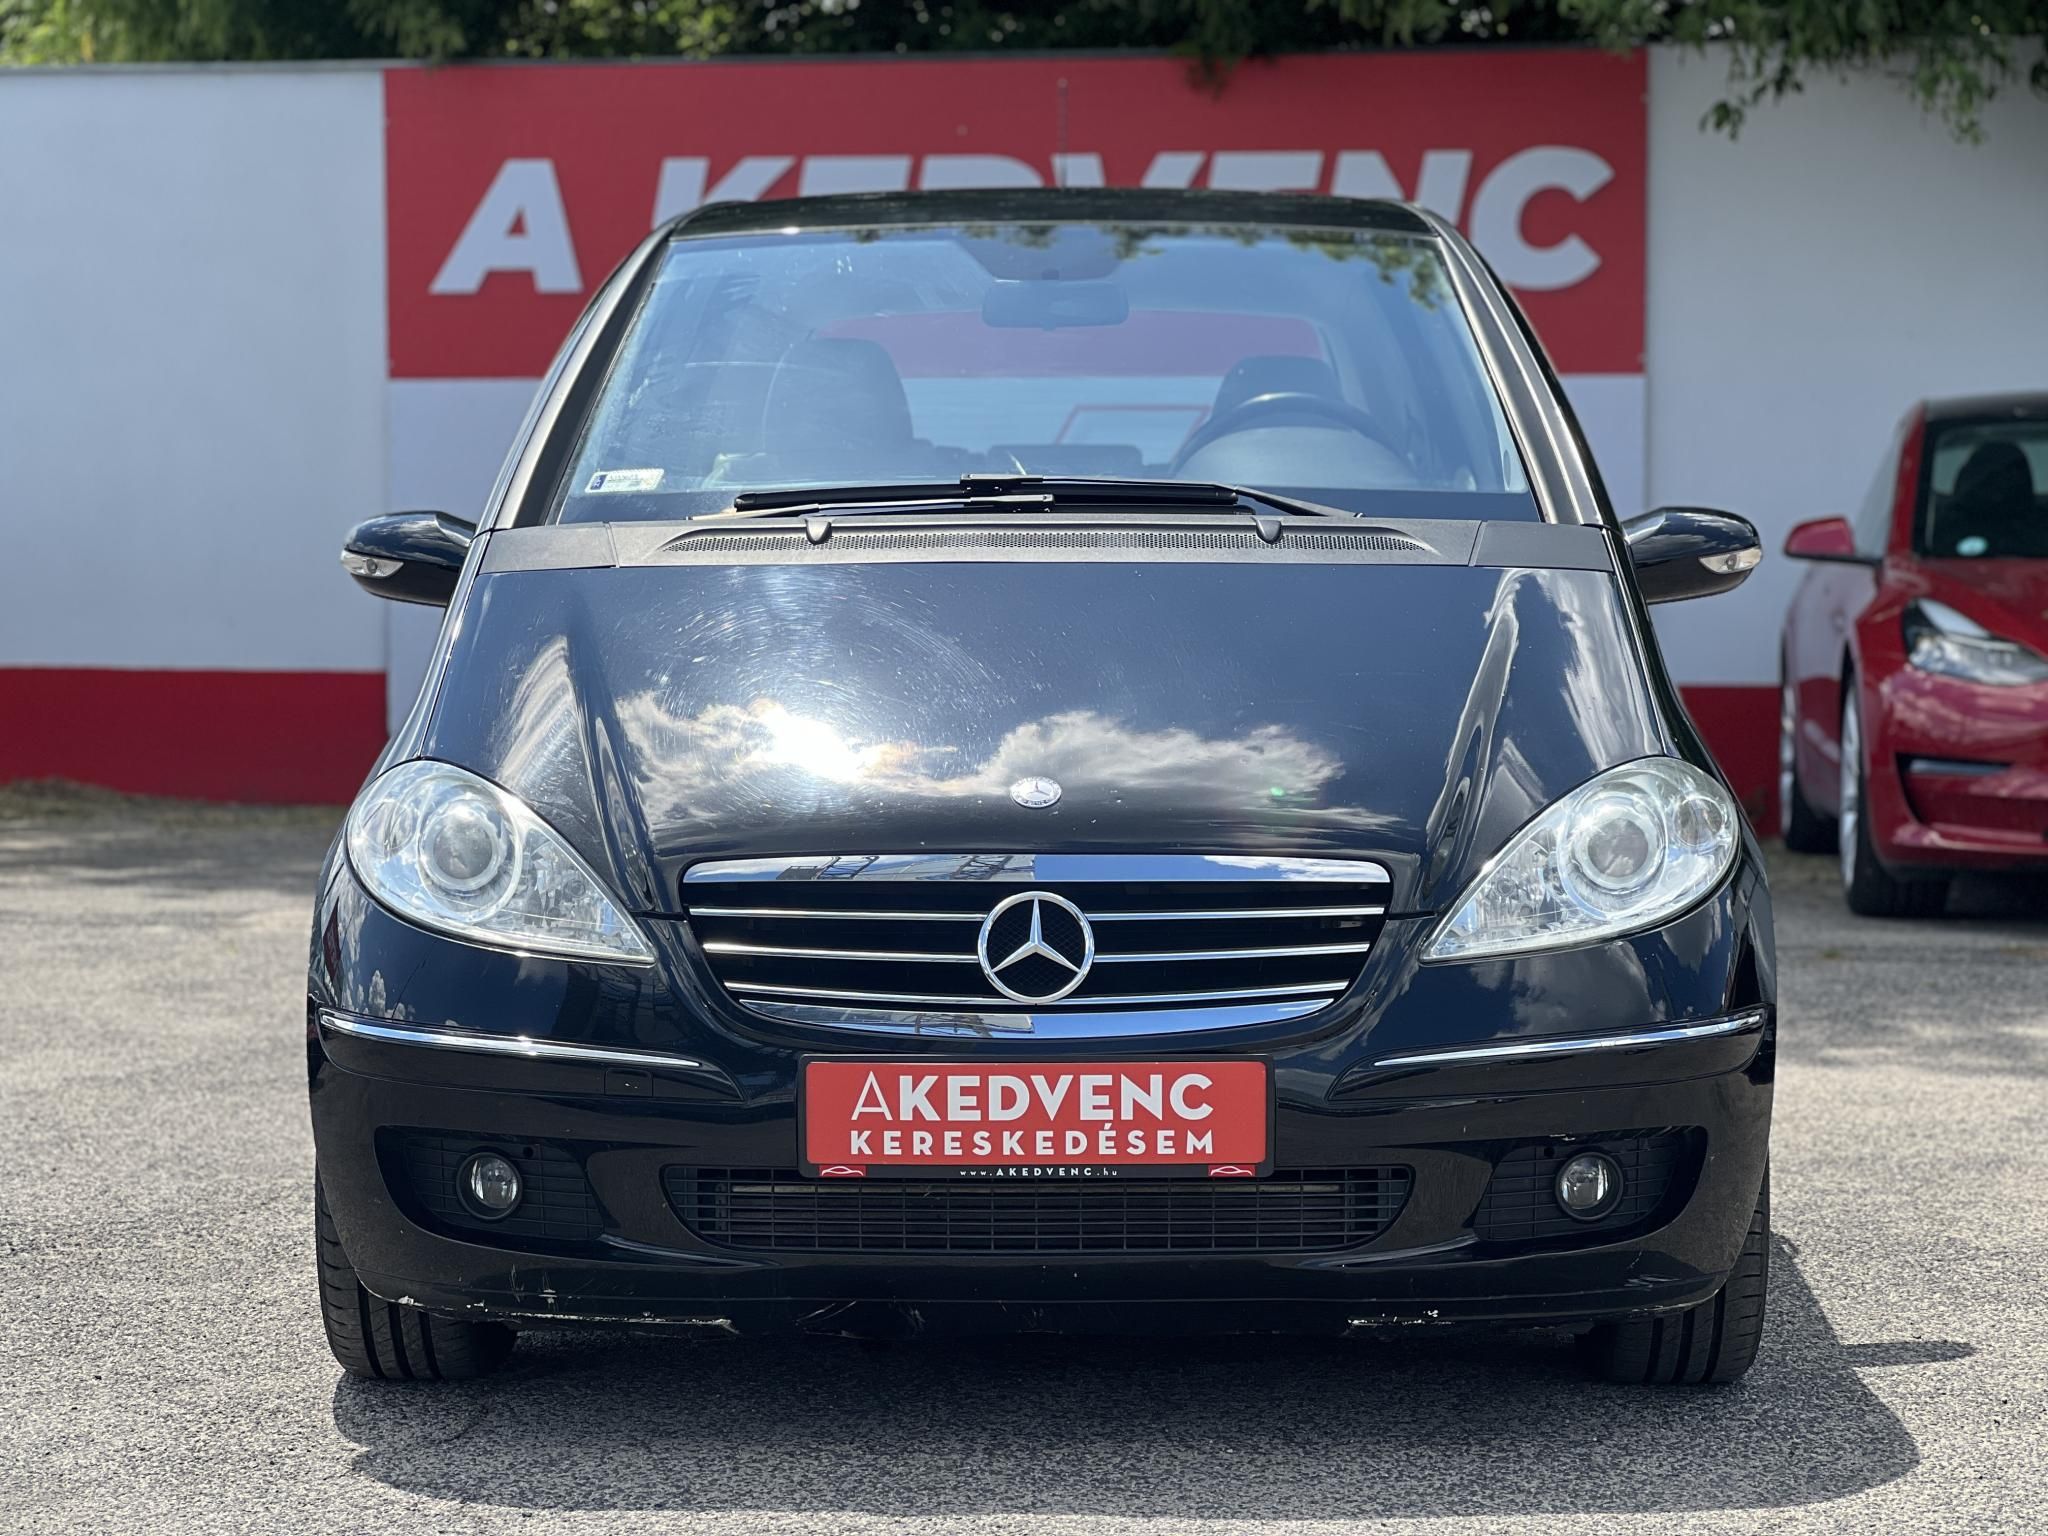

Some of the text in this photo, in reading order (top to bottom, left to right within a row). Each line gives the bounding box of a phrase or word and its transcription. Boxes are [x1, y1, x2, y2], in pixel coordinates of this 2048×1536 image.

[429, 158, 584, 294] A
[850, 1070, 1214, 1121] AKEDVENC
[850, 1122, 1214, 1156] KERESKEDÉSEM
[959, 1167, 1118, 1177] www.AKEDVENC.hu
